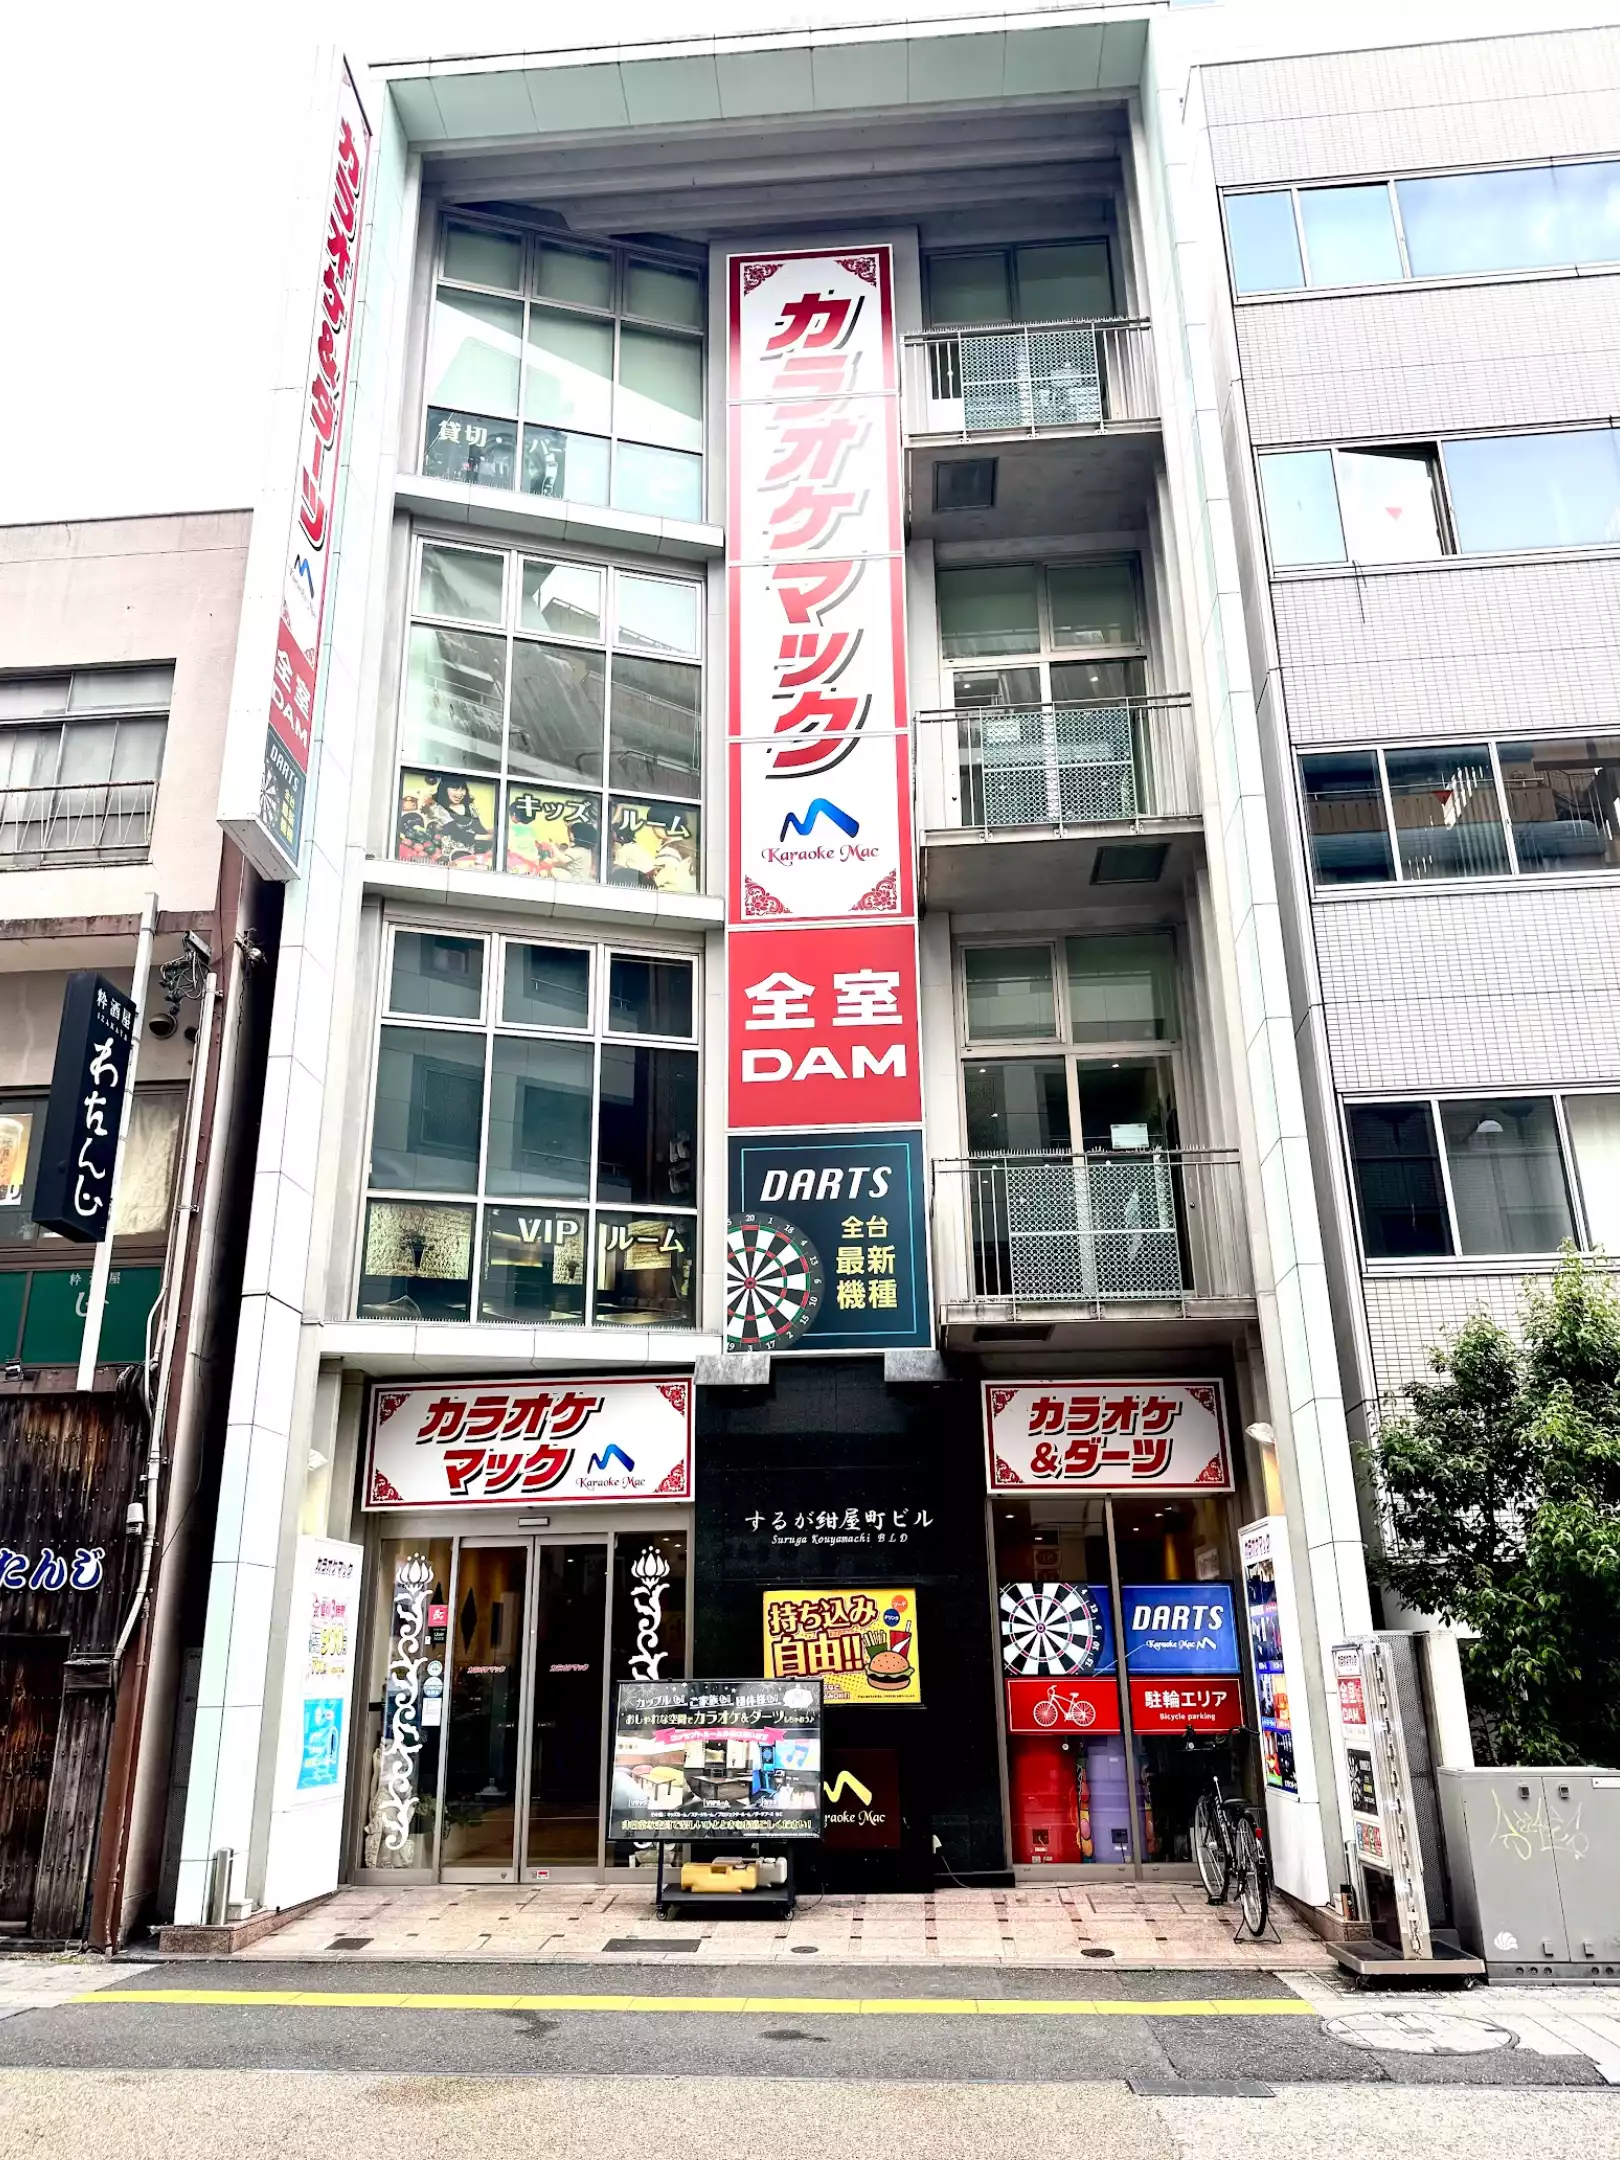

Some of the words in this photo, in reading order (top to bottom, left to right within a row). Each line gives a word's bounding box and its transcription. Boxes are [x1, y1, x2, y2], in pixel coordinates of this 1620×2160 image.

[757, 289, 873, 780] カラオケマック
[272, 684, 307, 748] DAM
[269, 744, 300, 793] DARTS
[761, 846, 835, 867] Karaoke
[840, 843, 879, 863] Mac
[743, 968, 903, 1030] 全室
[741, 1044, 907, 1083] DAM
[760, 1166, 892, 1202] DARTS
[745, 1214, 755, 1222] 20
[768, 1217, 773, 1225] 1
[784, 1224, 794, 1234] 18
[841, 1215, 889, 1239] 全台
[517, 1217, 579, 1244] VIP
[607, 1226, 684, 1253] ルーム
[835, 1244, 896, 1275] 最新
[69, 1271, 121, 1286] 粋屋
[836, 1278, 898, 1310] 機種
[765, 1341, 777, 1350] 17
[415, 1391, 605, 1445] カラオケ
[1028, 1395, 1183, 1436] カラオケ
[441, 1444, 576, 1496] マック
[1030, 1437, 1173, 1479] &ダーツ
[576, 1477, 620, 1490] Karaoke
[622, 1475, 645, 1488] Mac
[744, 1507, 934, 1532] するが紺屋町ビル
[771, 1534, 807, 1546] Suruga
[811, 1533, 871, 1546] Kouyamachi
[768, 1594, 879, 1637] 持ち込み
[1132, 1605, 1224, 1631] DARTS
[1144, 1690, 1228, 1709] 駐輪エリア
[1159, 1712, 1186, 1722] Bicycle
[1187, 1712, 1216, 1722] parking
[858, 1810, 886, 1826] Mac
